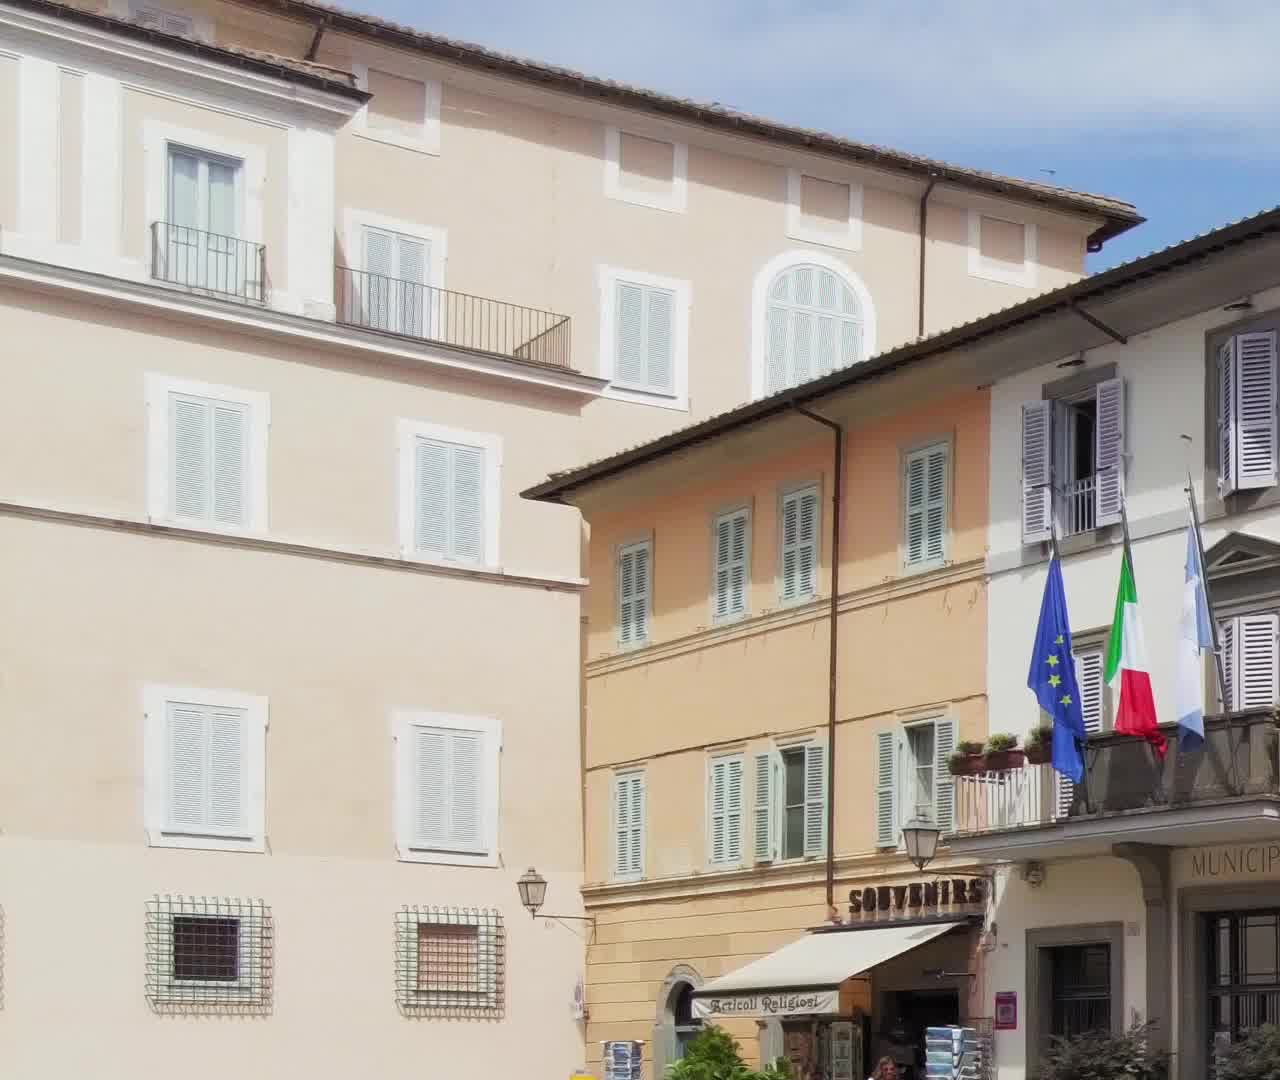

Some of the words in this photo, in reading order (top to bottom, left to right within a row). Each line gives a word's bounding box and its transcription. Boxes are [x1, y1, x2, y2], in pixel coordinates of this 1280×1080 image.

[849, 878, 985, 913] SOUVENIRS
[710, 998, 758, 1014] Articoli
[762, 995, 818, 1013] Religiosi
